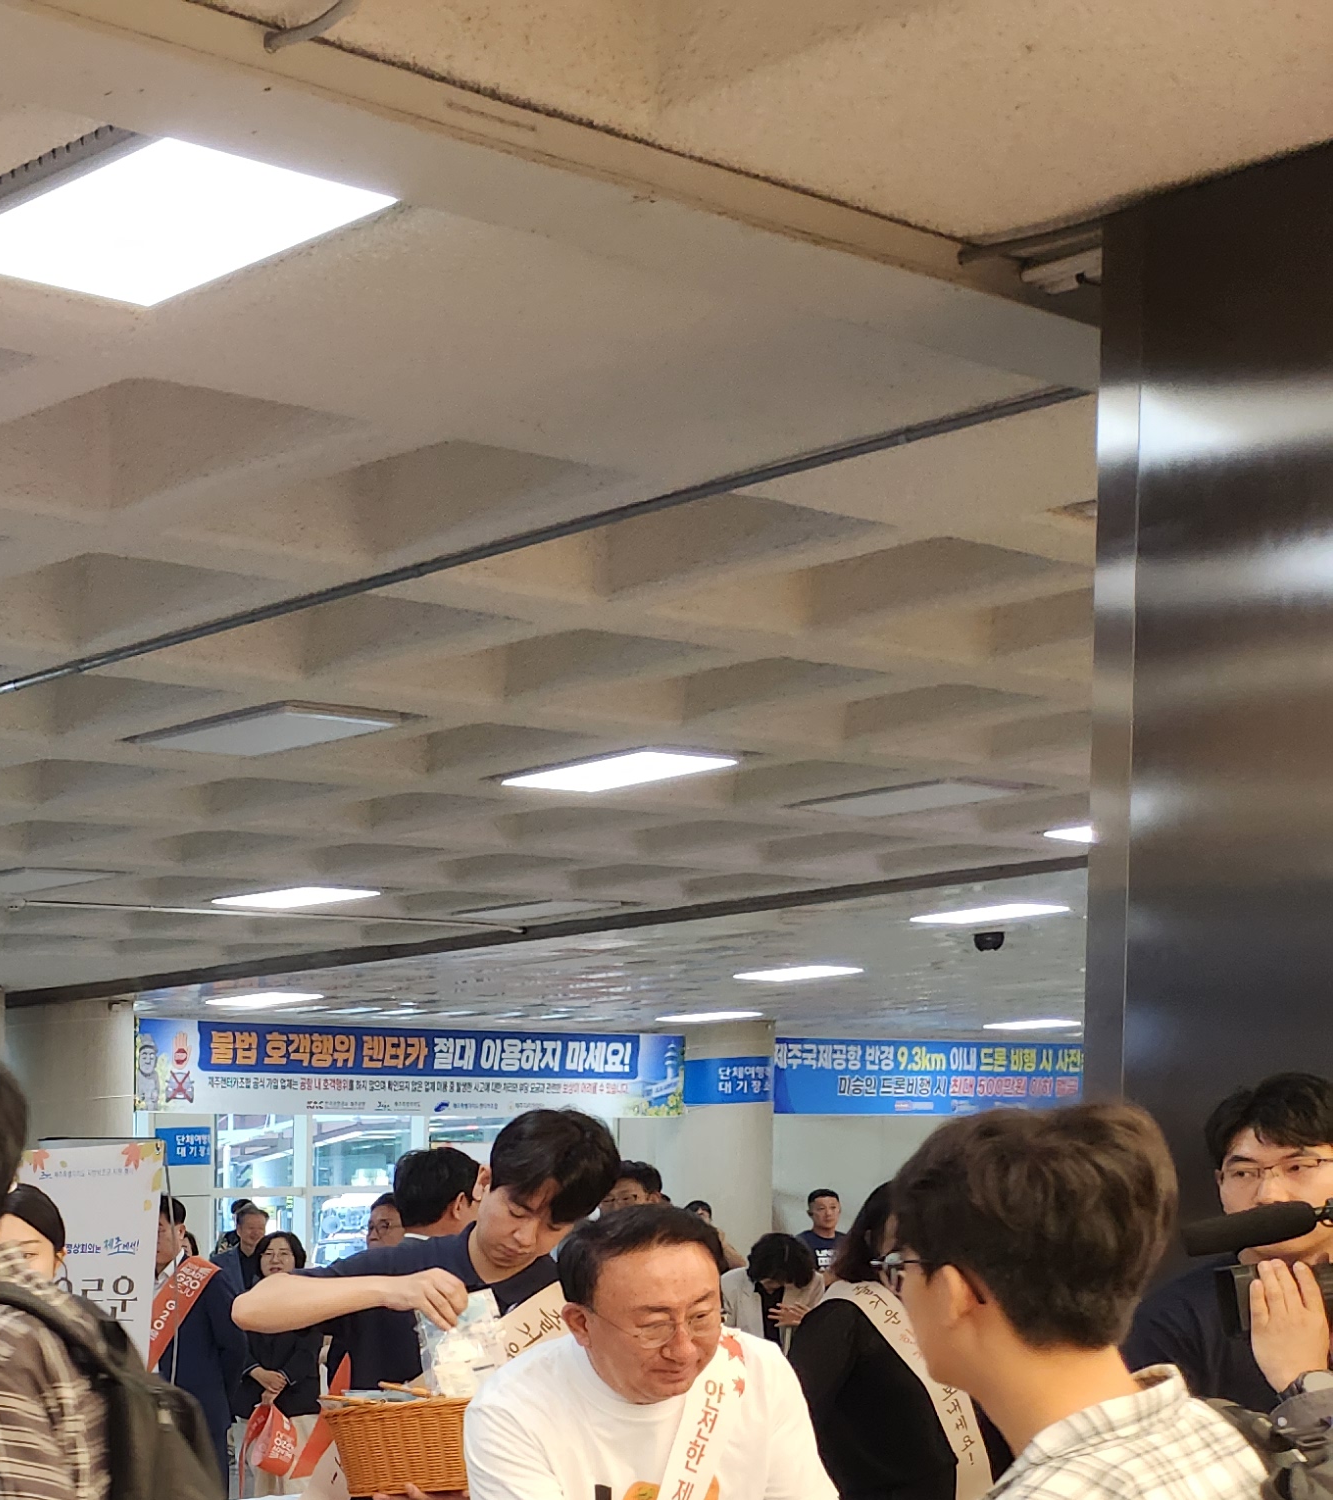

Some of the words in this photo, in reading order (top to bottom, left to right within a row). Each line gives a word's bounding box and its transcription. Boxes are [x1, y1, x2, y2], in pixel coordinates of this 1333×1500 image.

[209, 1030, 258, 1066] 불법
[263, 1031, 356, 1068] 호객행위
[361, 1035, 429, 1070] 렌터카
[433, 1036, 476, 1071] 절대
[480, 1038, 563, 1072] 이용하지
[565, 1040, 633, 1073] 마세요!
[774, 1043, 863, 1072] 제주국제공항
[865, 1045, 894, 1071] 반경
[897, 1045, 947, 1071] 9.3km
[949, 1046, 977, 1071] 이내
[979, 1047, 1008, 1071] 드론
[1010, 1048, 1036, 1072] 비행
[1040, 1048, 1054, 1072] 시
[837, 1075, 877, 1096] 미승인
[880, 1075, 931, 1098] 드론비행
[934, 1076, 948, 1097] 시
[176, 1272, 201, 1290] G20
[685, 1378, 726, 1474] 안전한
